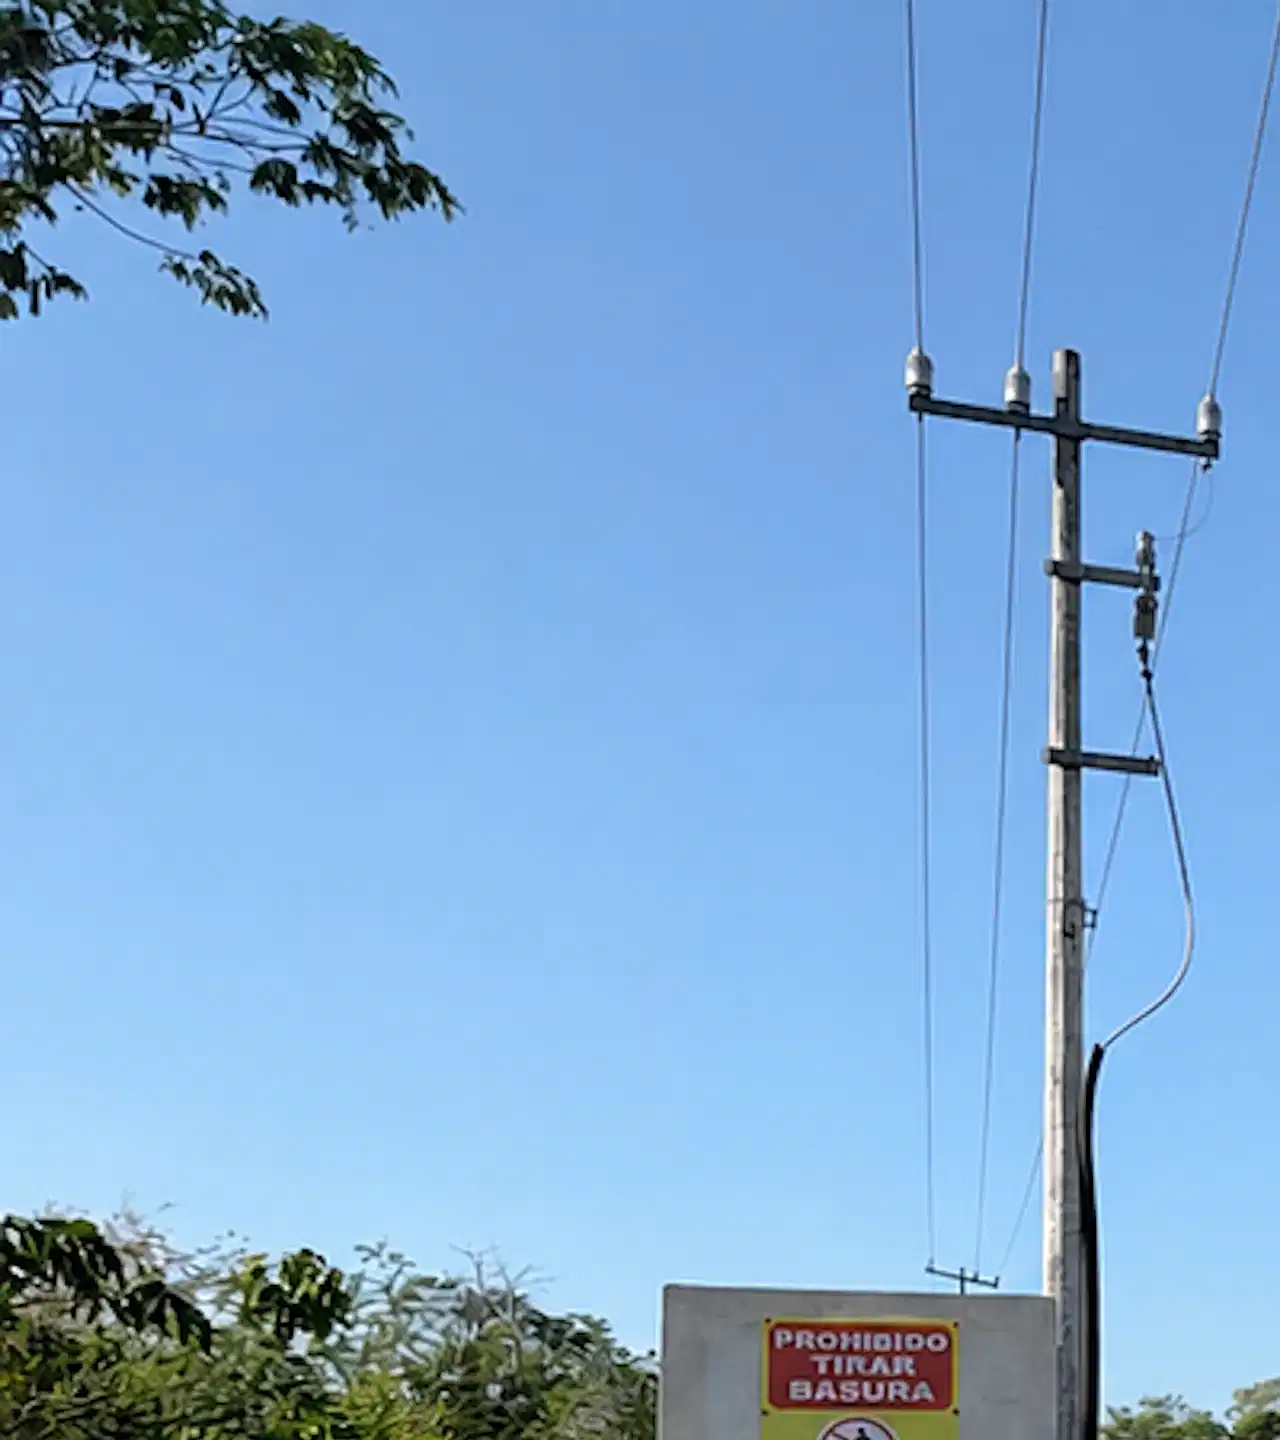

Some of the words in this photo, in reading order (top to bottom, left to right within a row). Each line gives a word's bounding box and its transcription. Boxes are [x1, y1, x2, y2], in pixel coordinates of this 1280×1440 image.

[774, 1328, 949, 1352] PROHIBIDO
[811, 1354, 916, 1376] TIRAR
[788, 1380, 935, 1402] BASURA
